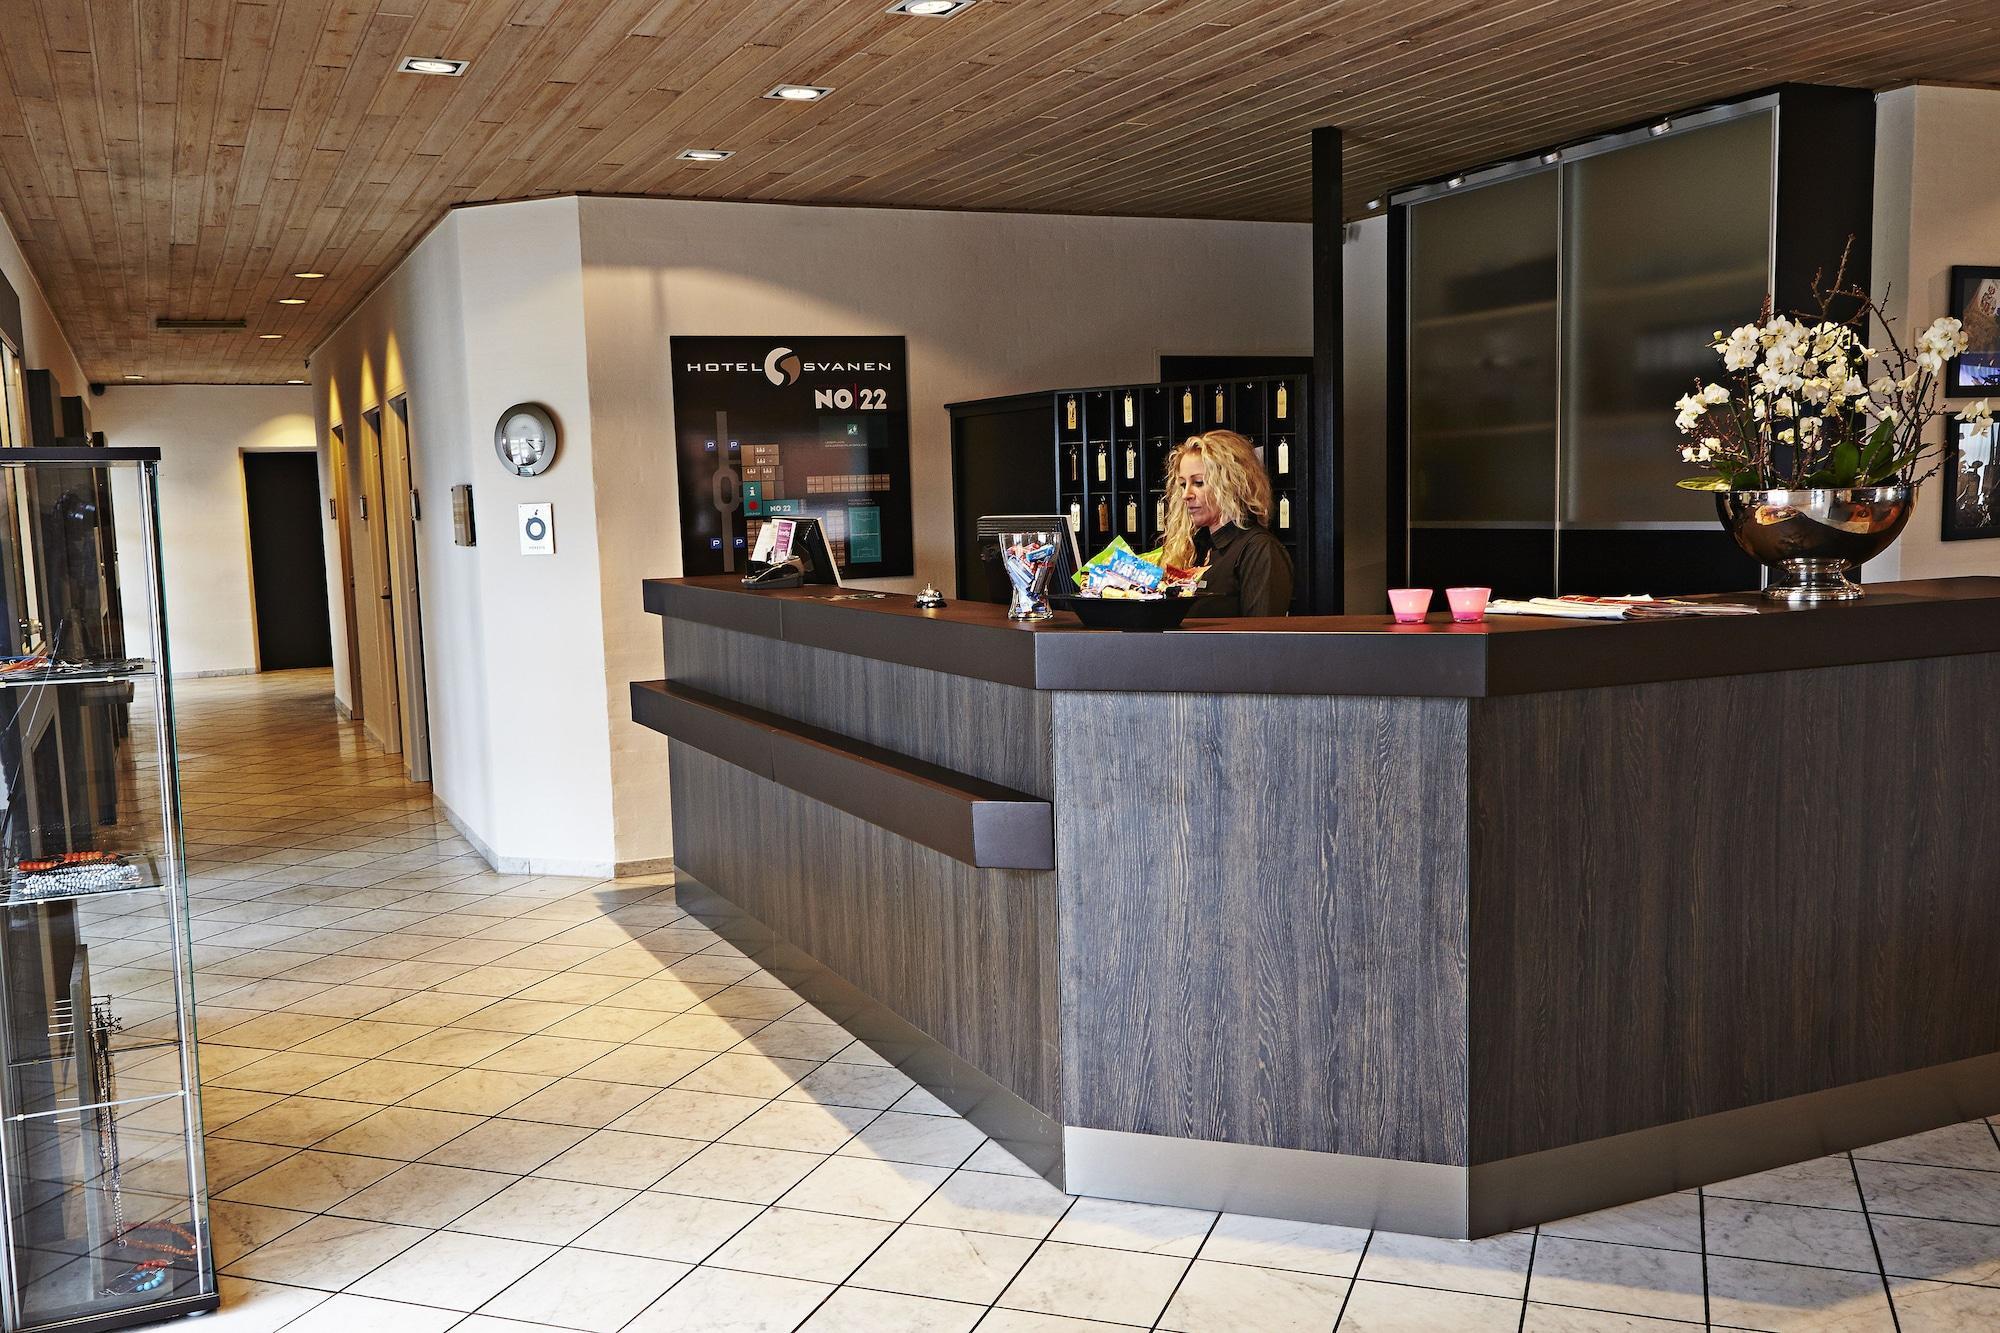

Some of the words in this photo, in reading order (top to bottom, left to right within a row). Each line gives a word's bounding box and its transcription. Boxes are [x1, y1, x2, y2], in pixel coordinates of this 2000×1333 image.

[687, 363, 763, 372] HOTEL
[803, 362, 892, 371] SVANEN
[814, 388, 853, 410] NO
[859, 388, 888, 410] 22
[782, 504, 791, 512] 22
